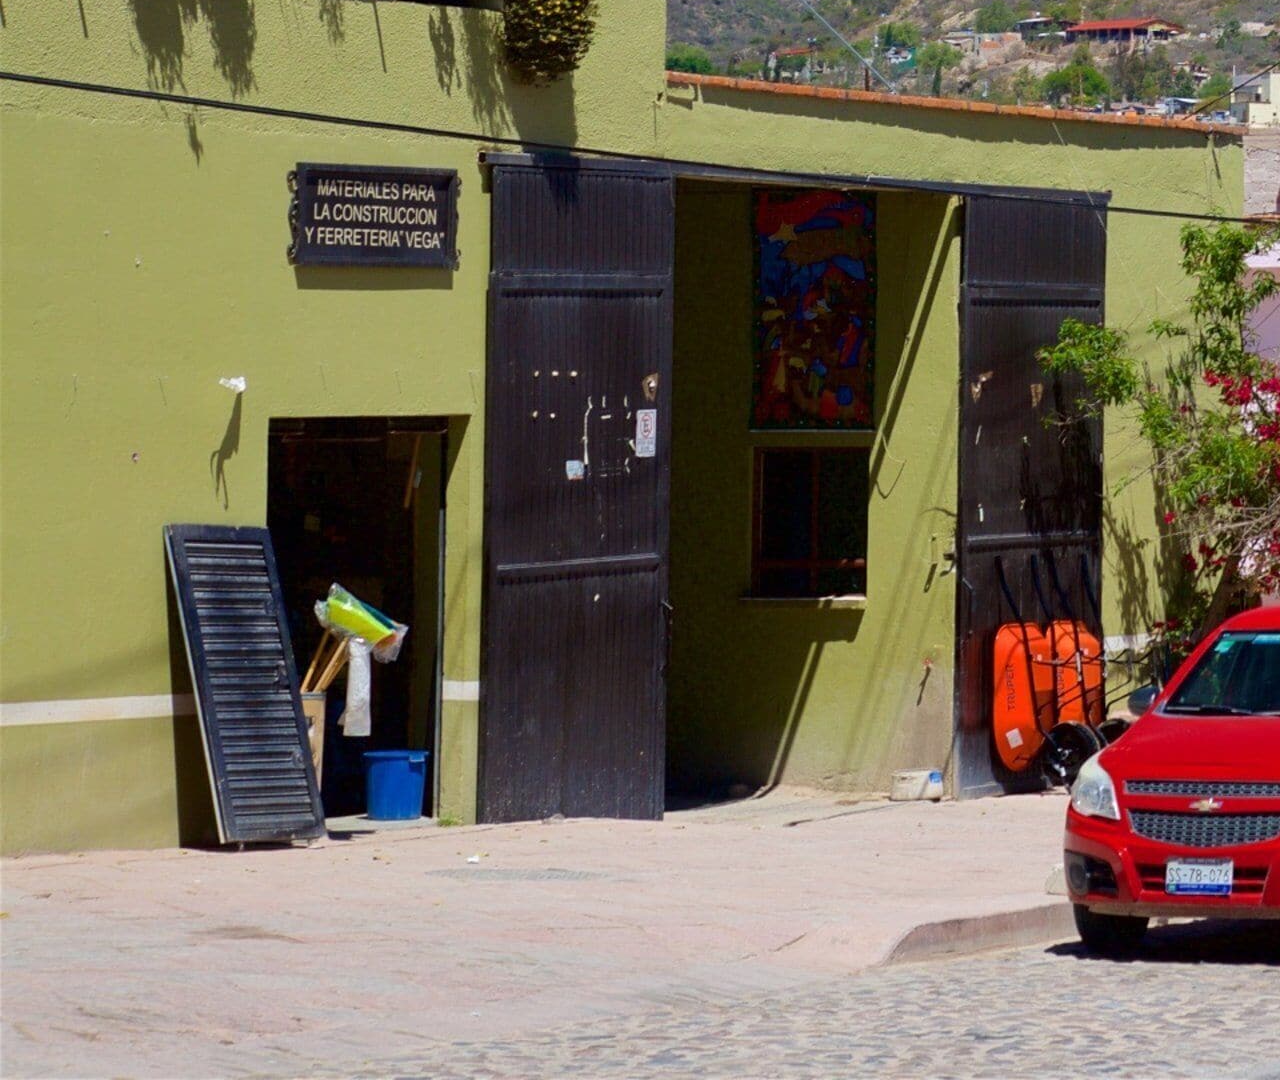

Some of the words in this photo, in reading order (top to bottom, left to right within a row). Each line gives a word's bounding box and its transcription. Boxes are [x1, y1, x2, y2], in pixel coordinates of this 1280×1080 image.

[317, 179, 399, 200] MATERIALES
[402, 183, 436, 202] PARA
[313, 202, 331, 220] LA
[332, 203, 438, 225] CONSTRUCCION
[305, 226, 315, 244] Y
[317, 227, 400, 247] FERRETERIA
[1006, 663, 1016, 711] TRUPER
